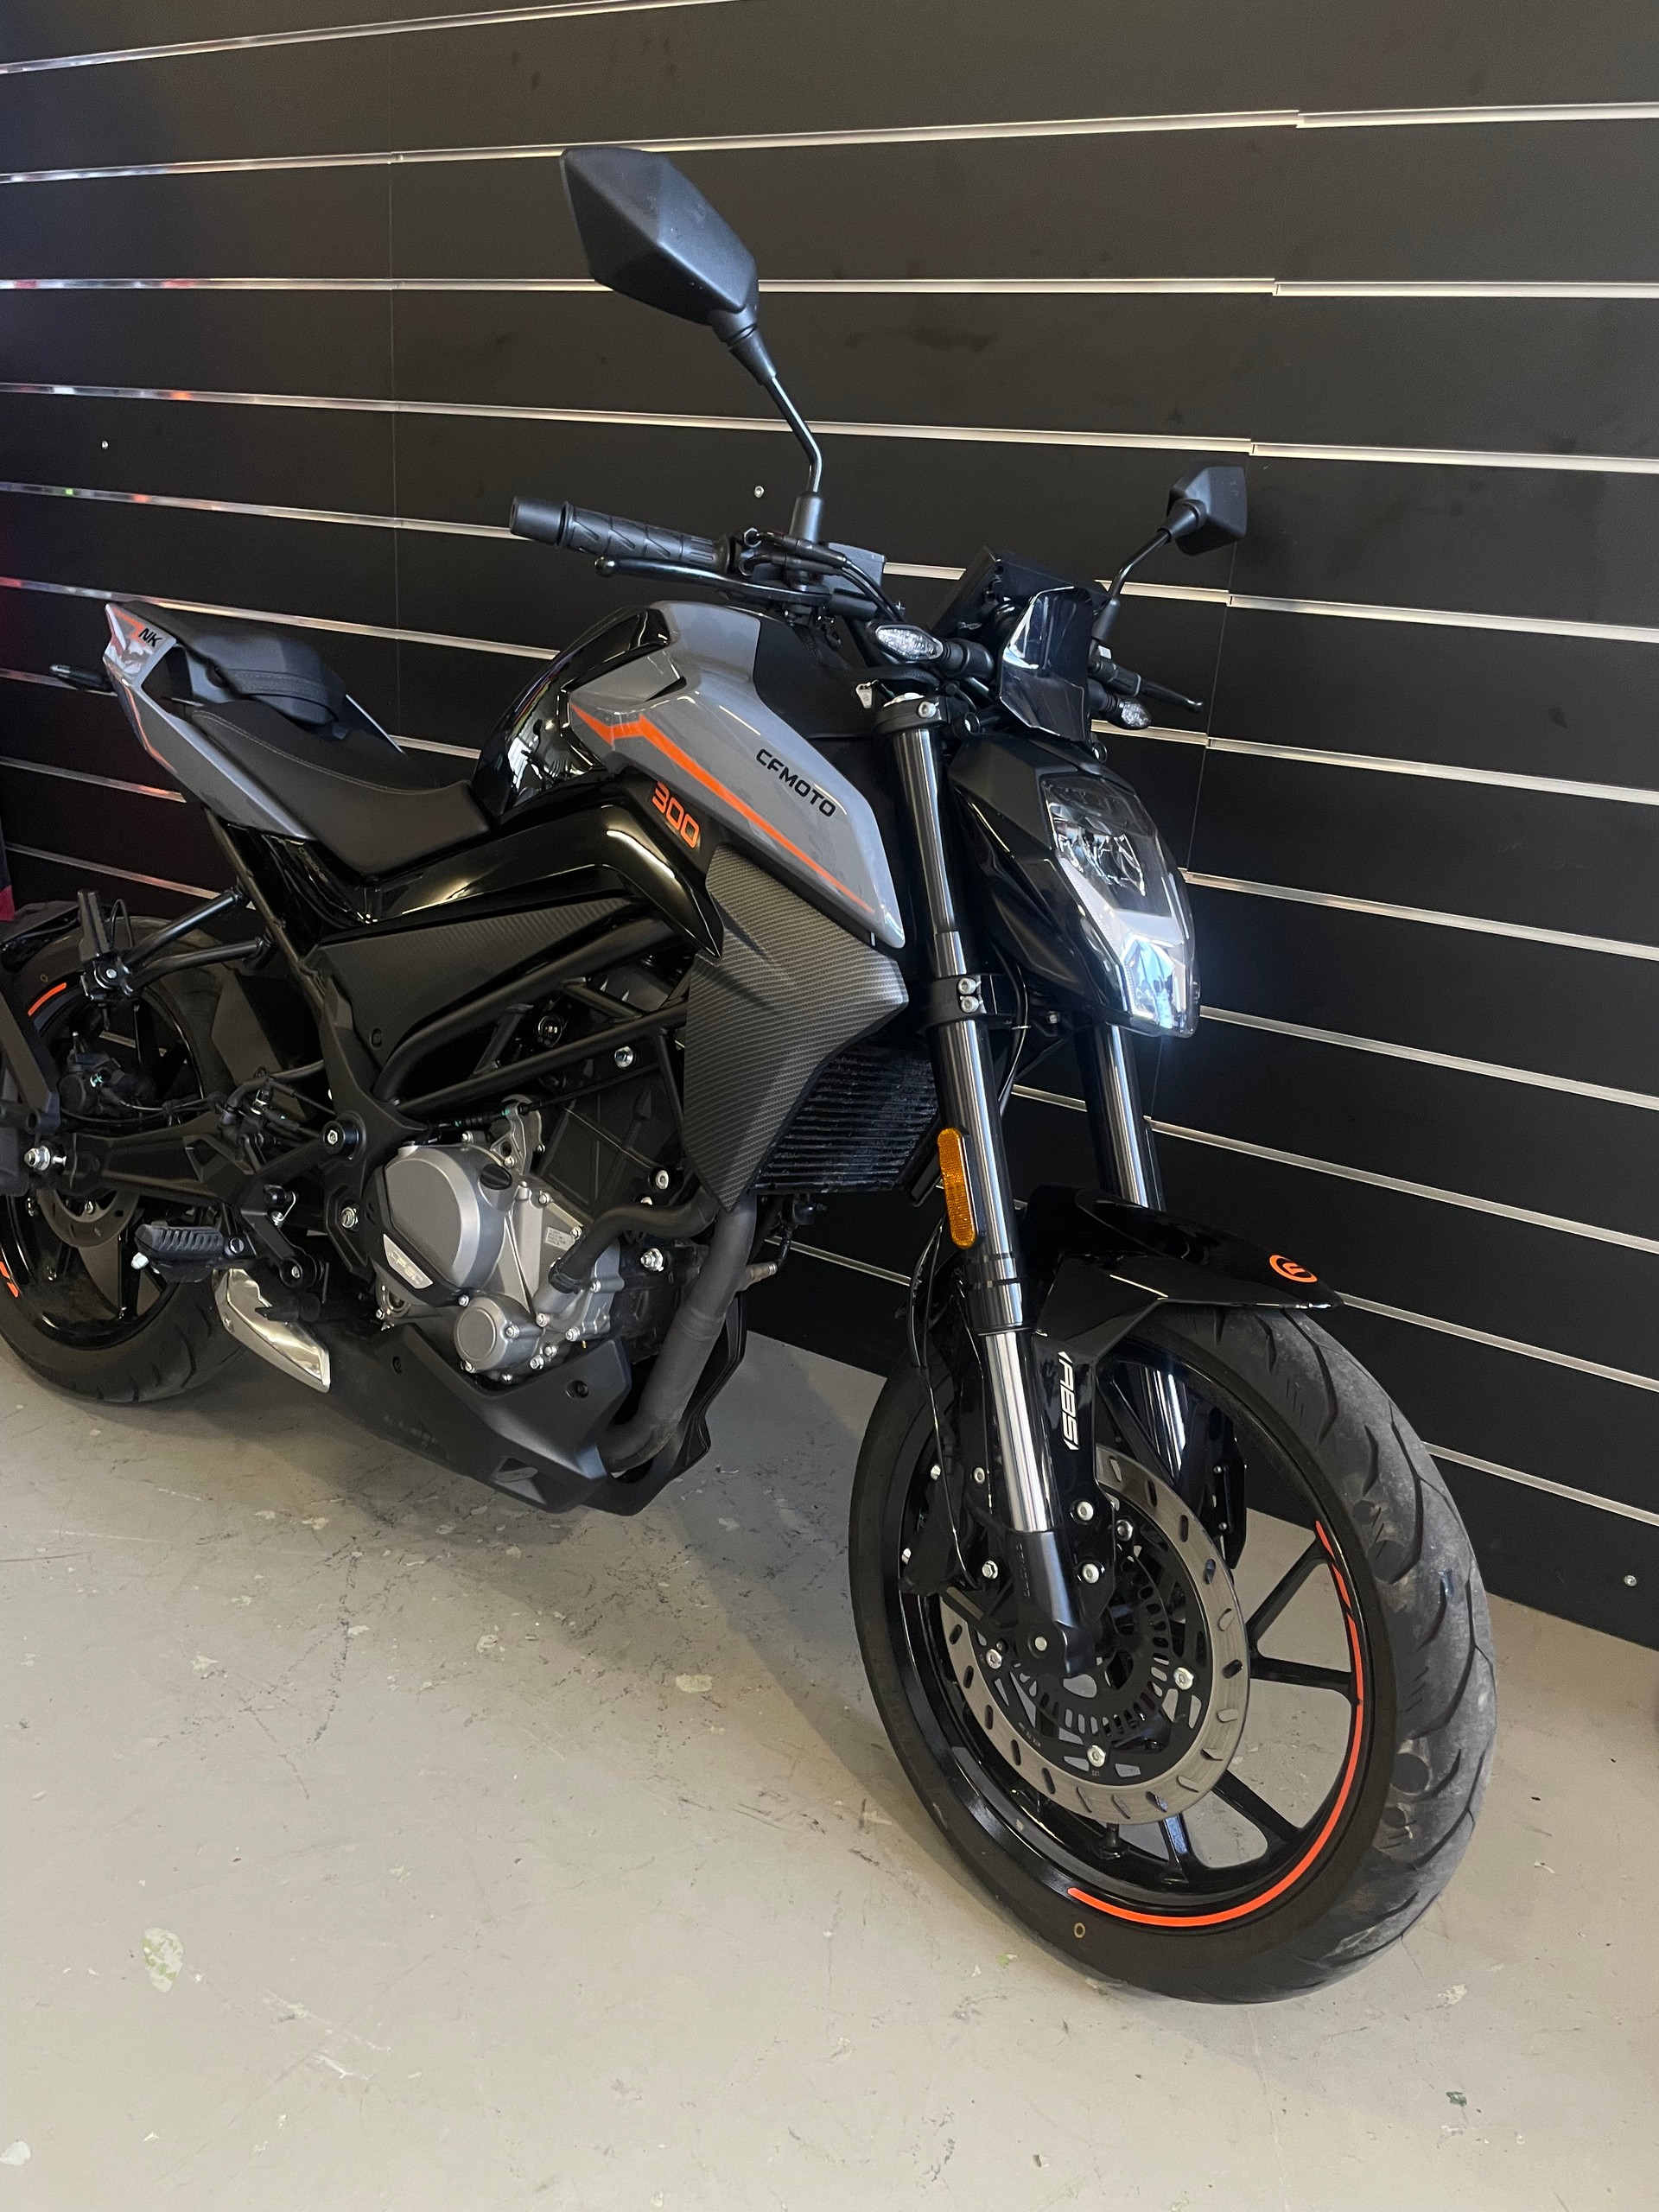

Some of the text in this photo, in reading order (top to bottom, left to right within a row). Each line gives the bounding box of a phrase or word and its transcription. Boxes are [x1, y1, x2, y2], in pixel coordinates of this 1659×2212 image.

[138, 627, 162, 647] NK
[652, 780, 700, 849] 300
[756, 748, 836, 817] CFMOTO
[1058, 1357, 1078, 1446] ABS
